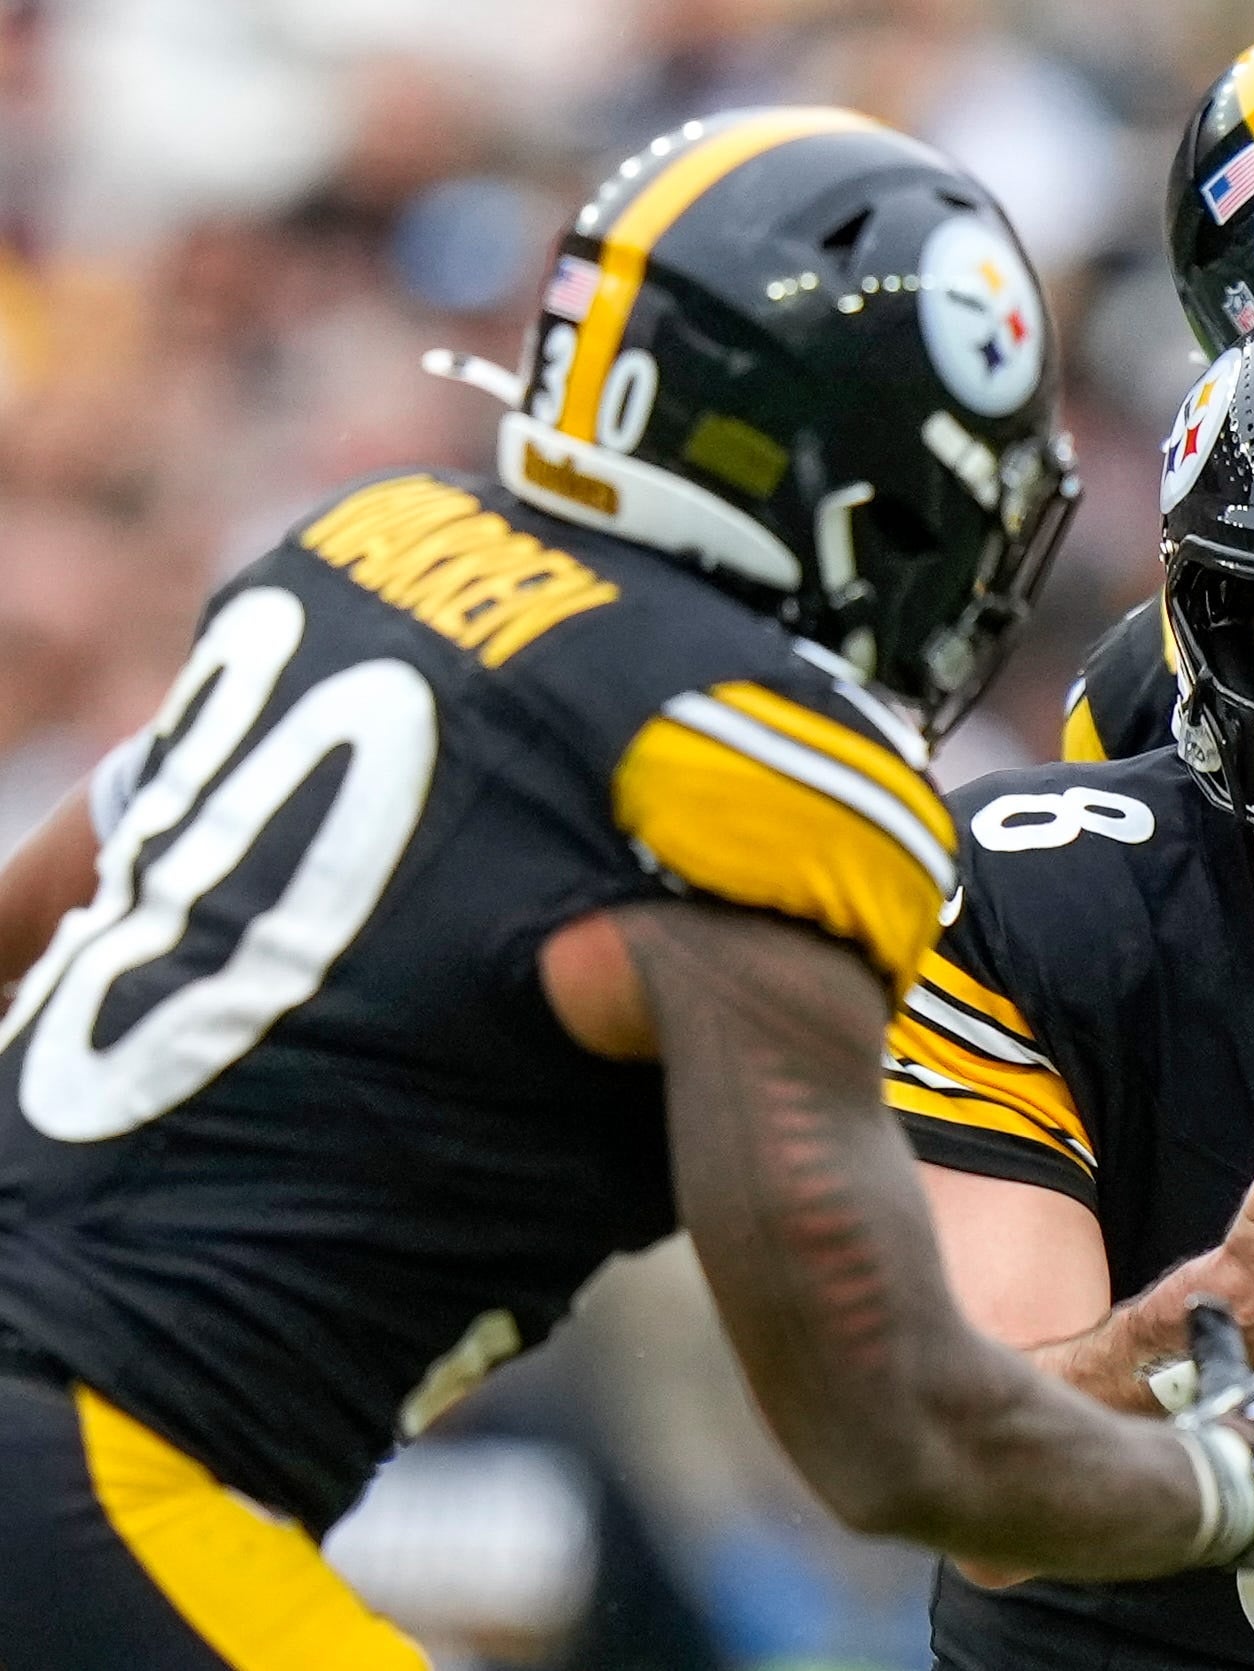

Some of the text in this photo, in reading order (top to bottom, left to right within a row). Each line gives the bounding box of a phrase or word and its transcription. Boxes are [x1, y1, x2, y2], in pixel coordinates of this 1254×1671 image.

[531, 322, 659, 453] 30
[302, 473, 620, 669] WARREN
[970, 786, 1155, 852] 8
